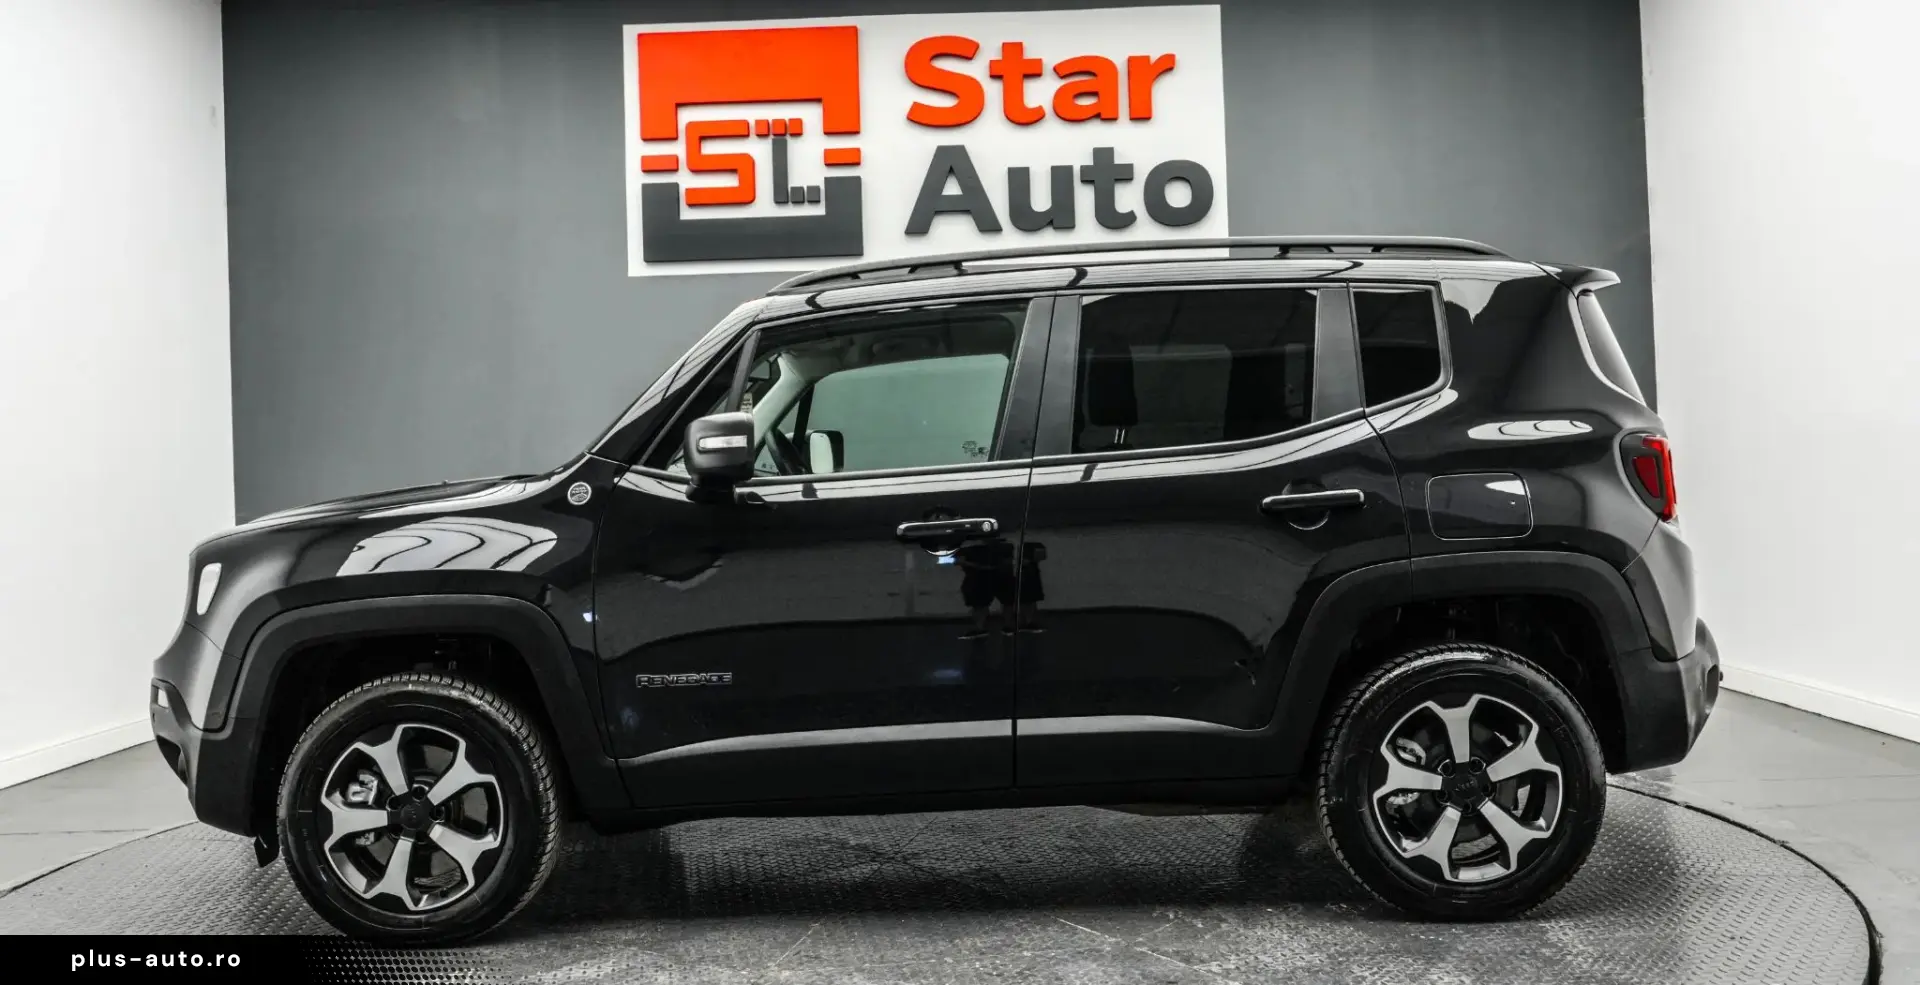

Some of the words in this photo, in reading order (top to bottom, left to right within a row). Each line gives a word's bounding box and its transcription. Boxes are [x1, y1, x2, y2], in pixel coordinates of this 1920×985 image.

[904, 35, 1176, 128] Star
[904, 144, 1214, 235] Auto
[636, 672, 732, 688] RENEGADE
